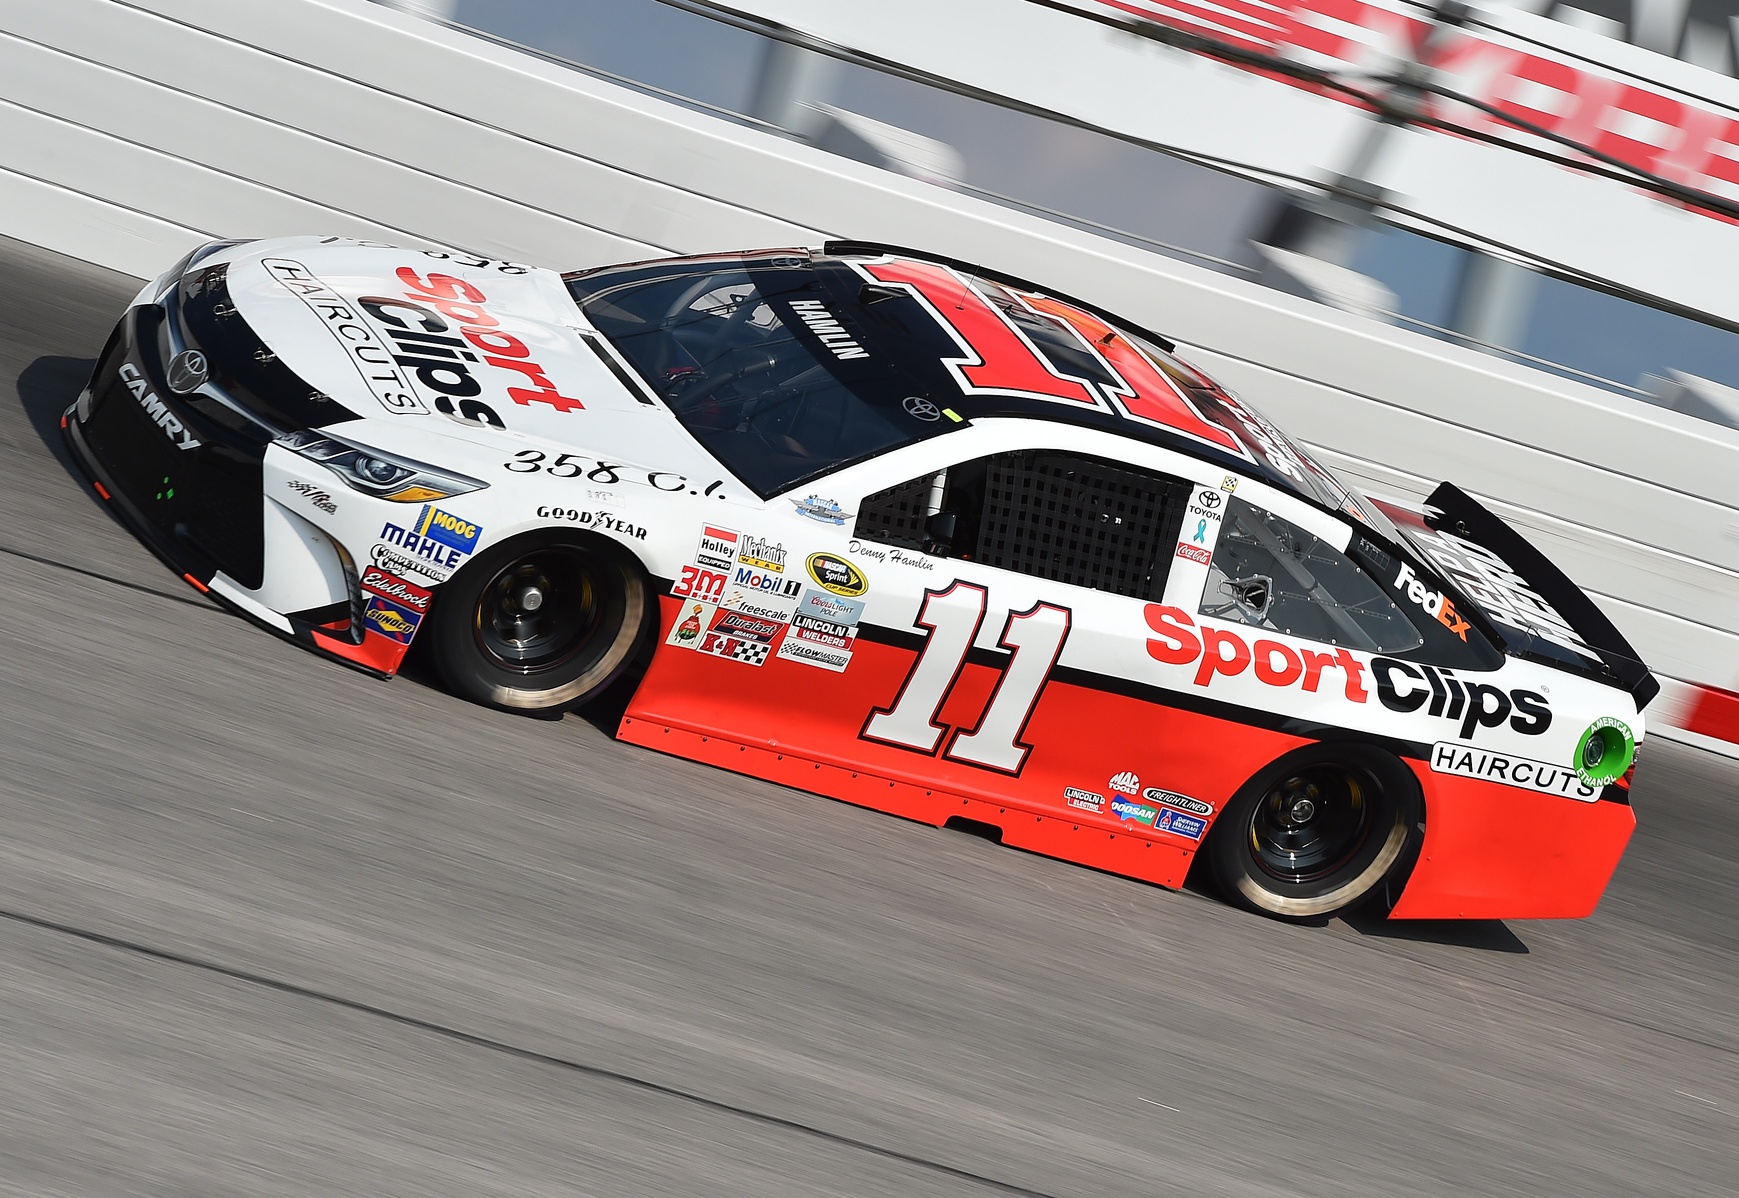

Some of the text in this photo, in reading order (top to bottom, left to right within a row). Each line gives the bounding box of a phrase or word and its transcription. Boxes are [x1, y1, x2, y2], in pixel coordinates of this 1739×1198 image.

[273, 265, 416, 409] HAIRCUTS
[395, 266, 586, 414] Sport
[788, 300, 871, 360] HAMLIN
[357, 296, 507, 431] Clips
[842, 254, 1258, 467] 11
[118, 362, 203, 451] CAMRY
[503, 450, 629, 485] 358
[432, 511, 476, 539] MOOG
[536, 505, 648, 541] GOODYEAR
[1189, 505, 1222, 522] TOYOTA
[380, 521, 462, 570] MAHLE
[701, 538, 735, 559] Holley
[741, 534, 787, 566] Mechanix
[848, 539, 934, 571] Denny Hamlin
[698, 555, 731, 570] EQUIPPED
[741, 556, 782, 571] WEAR
[823, 560, 848, 574] NASCAR
[673, 564, 729, 597] 3M
[734, 567, 801, 596] Mobil 1
[825, 570, 848, 584] Sprint
[362, 573, 430, 609] Edelbrock
[1393, 560, 1472, 643] FedEx
[367, 608, 414, 634] SUNOCO
[738, 601, 788, 622] freescale
[820, 607, 838, 618] POLE
[724, 614, 777, 635] Duralast
[732, 629, 759, 641] BRAKES
[794, 616, 847, 637] LINCOLN
[700, 632, 741, 657] K&N
[801, 629, 847, 648] WELDERS
[796, 646, 849, 665] FLOWMASTER
[857, 578, 1072, 778] 11
[1590, 717, 1632, 741] AMERICAN
[1109, 771, 1140, 790] MAC
[1576, 766, 1618, 787] ETHANOL
[1066, 788, 1101, 805] LINCOLN
[1107, 782, 1139, 796] TOOLS
[1072, 798, 1099, 811] ELECTRIC
[1149, 790, 1207, 813] FREIGHTLINER
